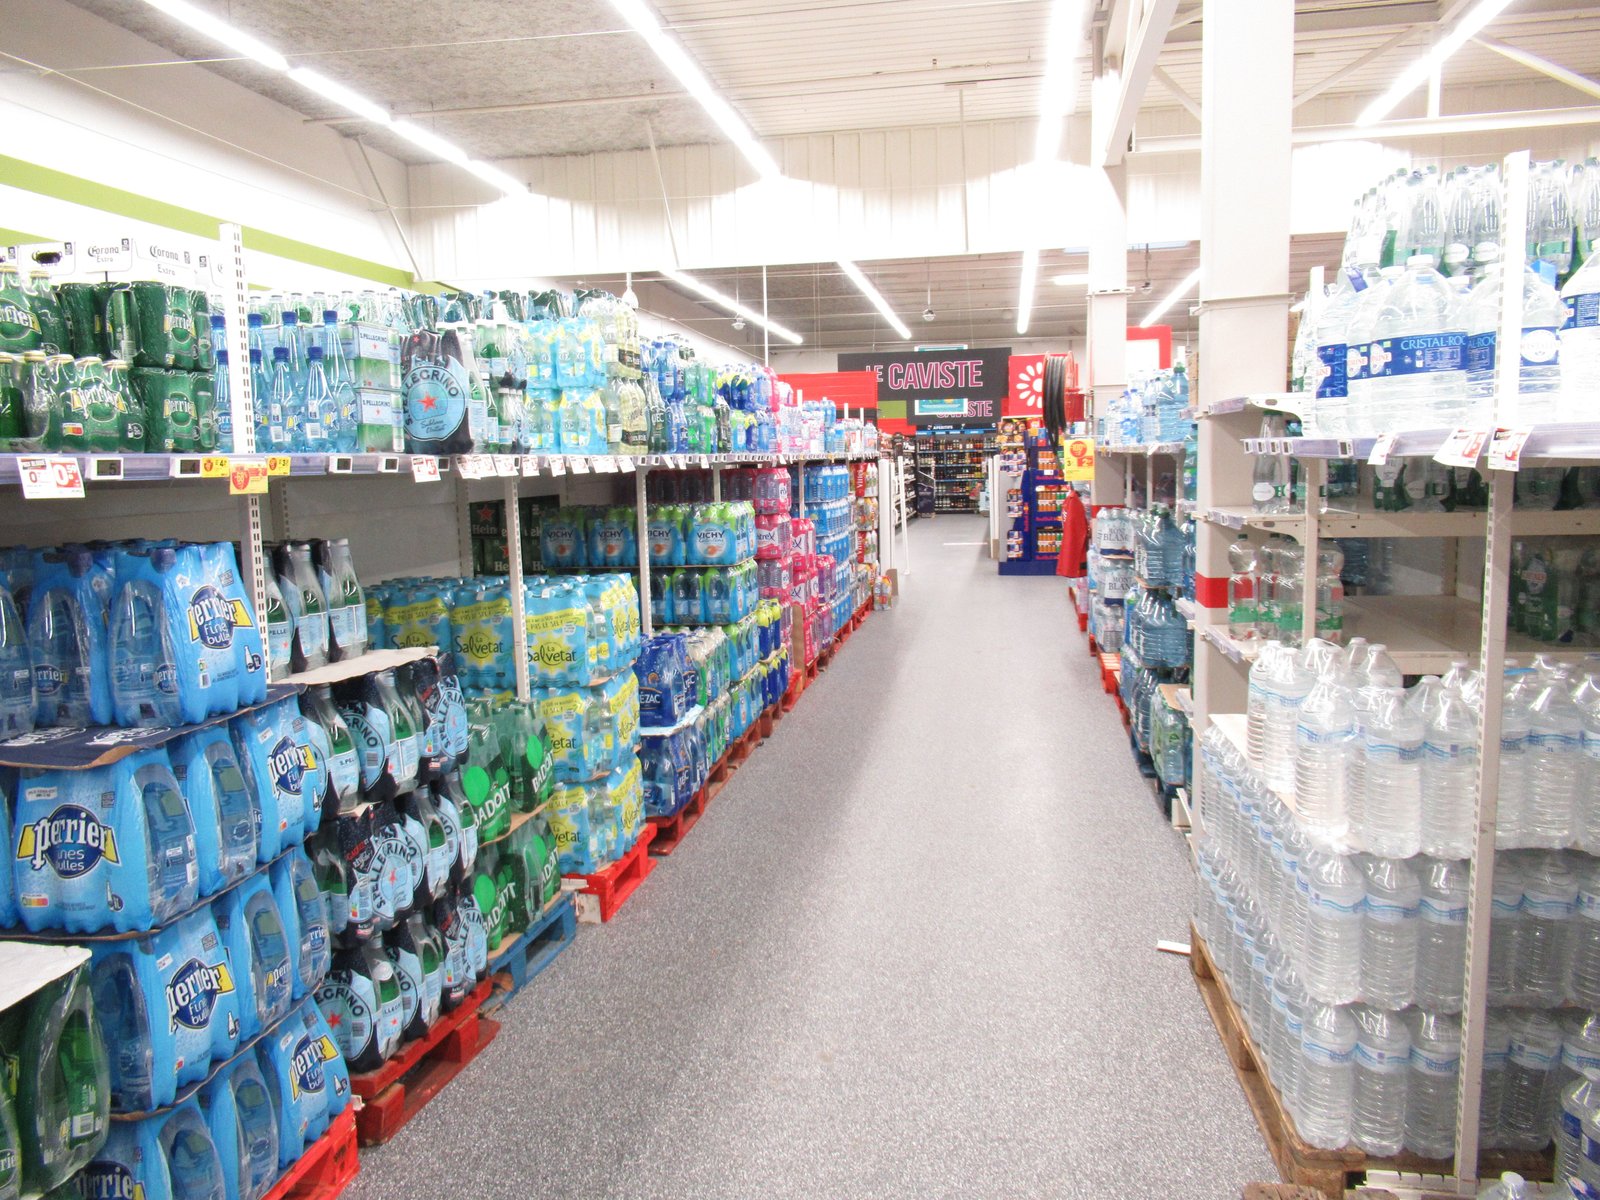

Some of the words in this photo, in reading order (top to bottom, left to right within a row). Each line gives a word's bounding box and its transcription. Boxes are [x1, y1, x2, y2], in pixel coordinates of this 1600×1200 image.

[88, 245, 119, 257] Corona
[888, 360, 984, 390] CAVISTE
[697, 530, 725, 539] VICHY
[455, 635, 504, 654] Salvetat
